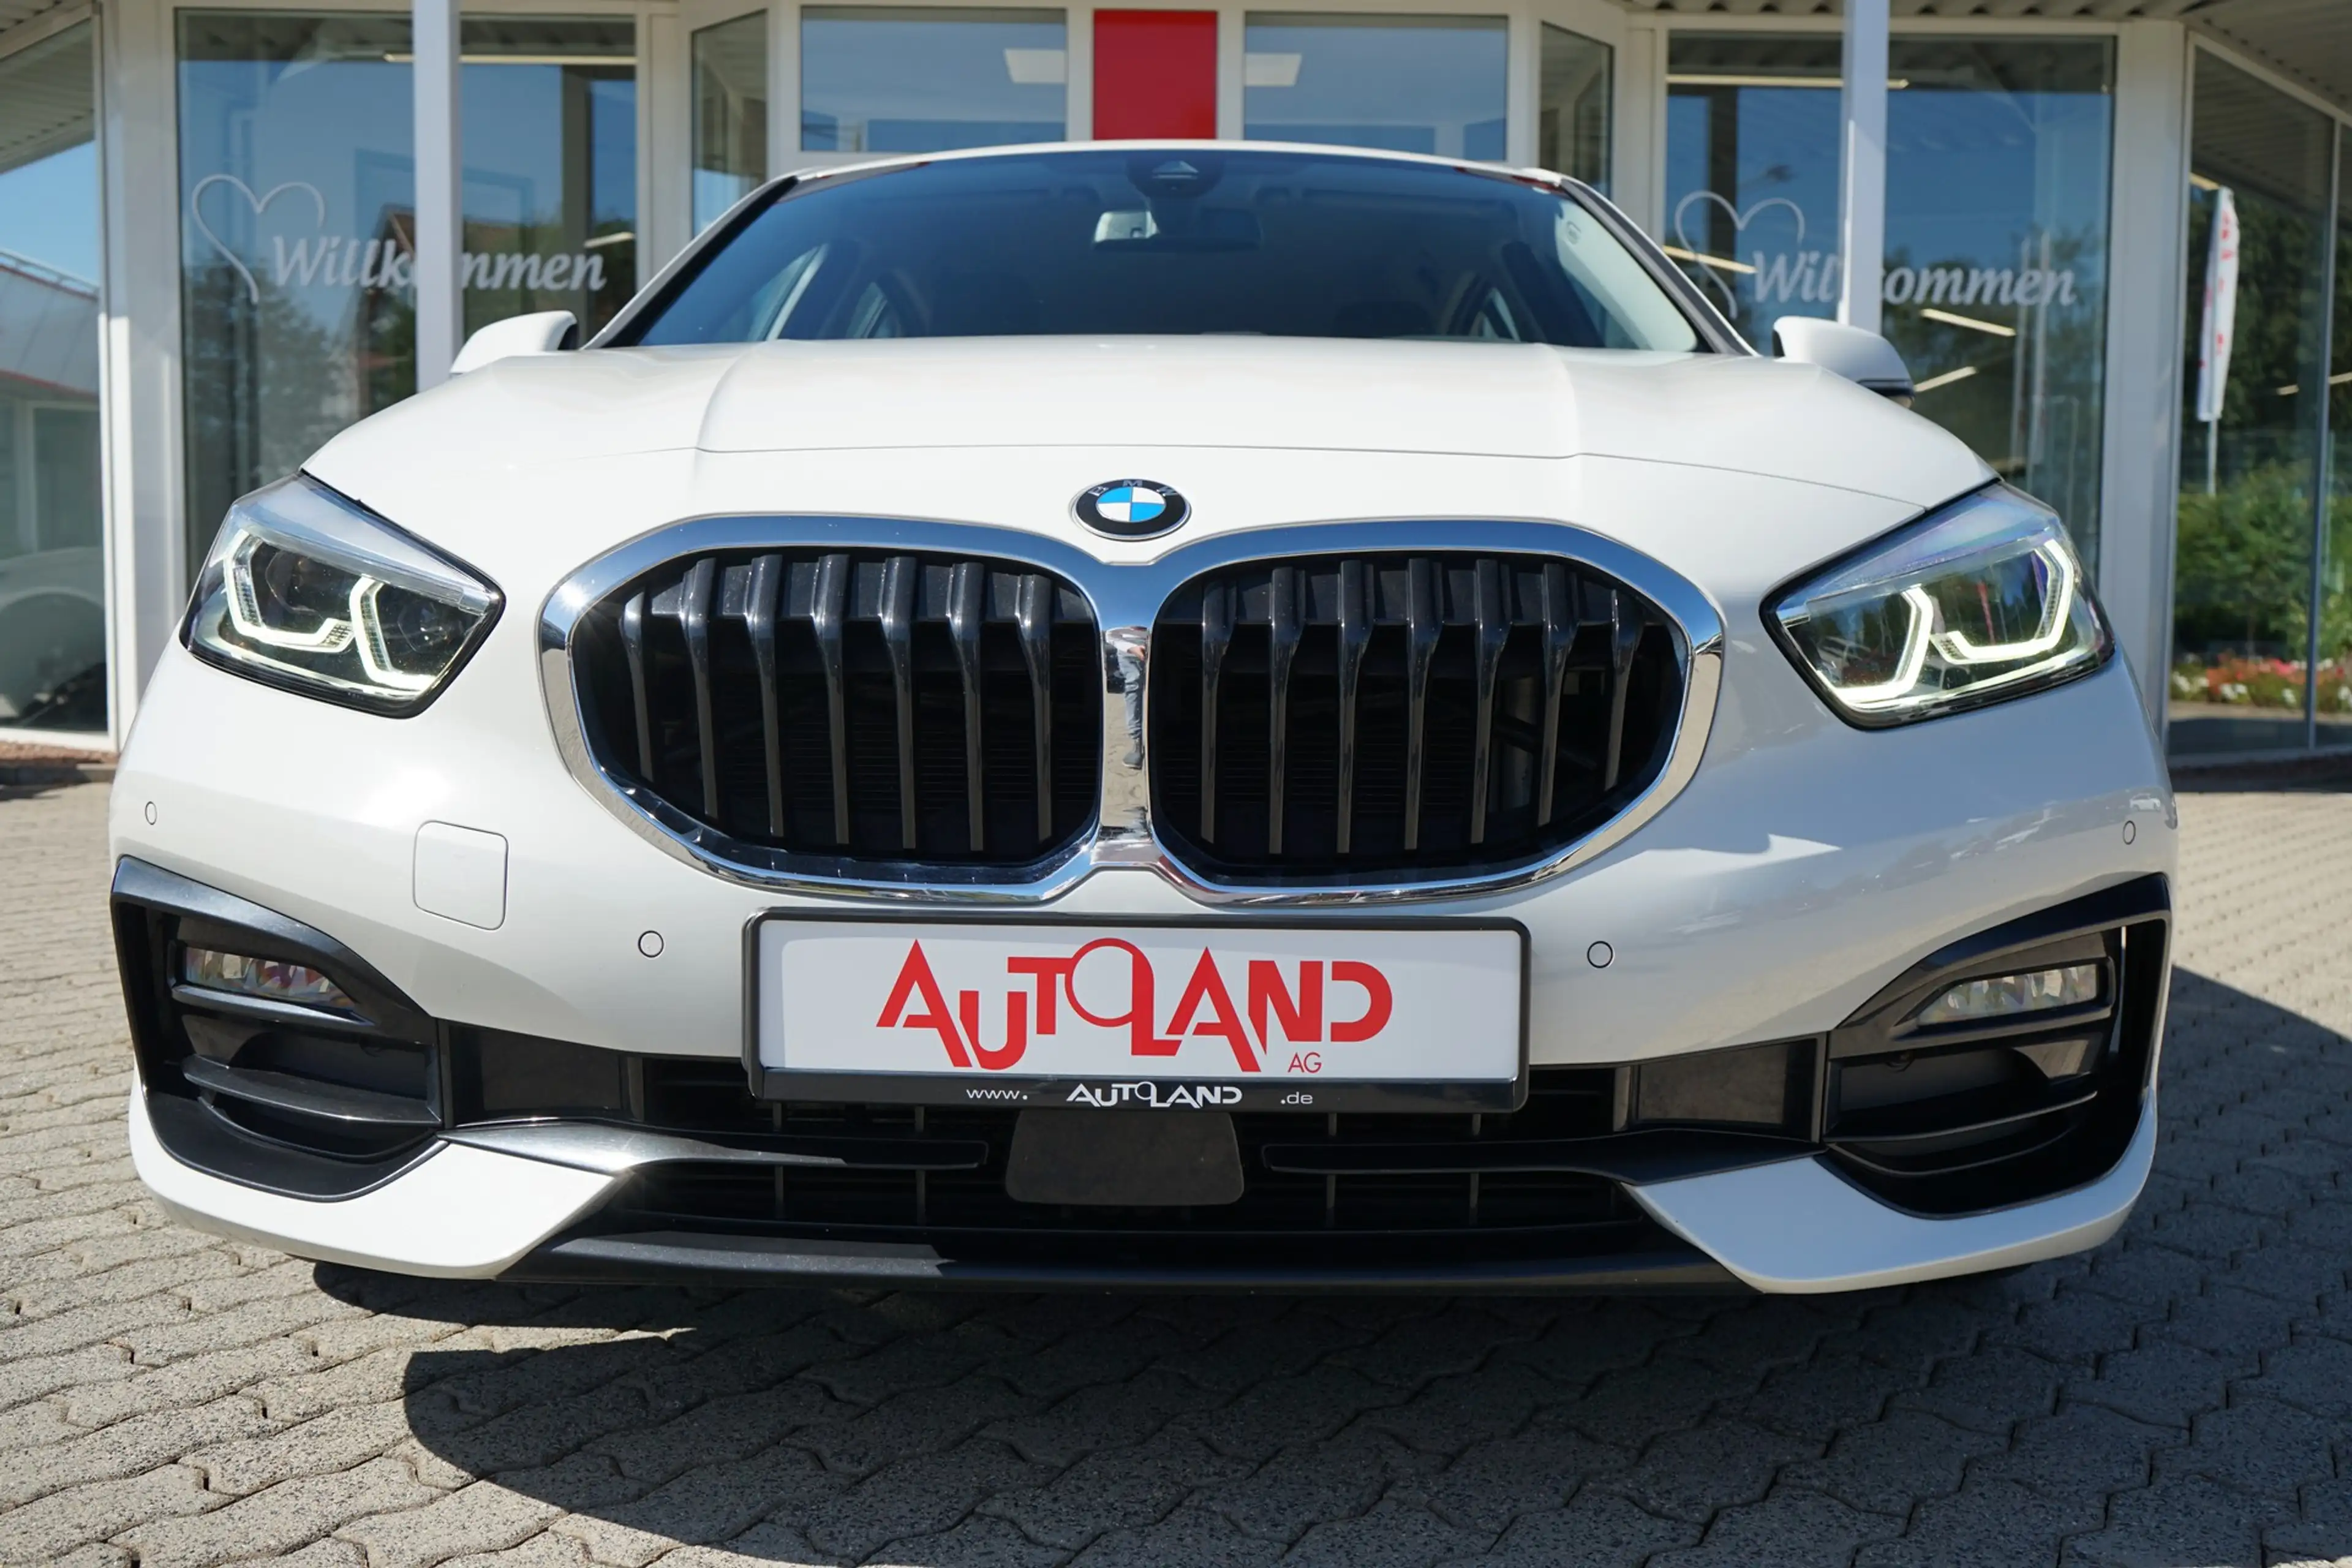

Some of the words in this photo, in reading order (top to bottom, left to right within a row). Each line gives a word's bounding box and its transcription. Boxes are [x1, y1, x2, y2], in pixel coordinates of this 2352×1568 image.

[273, 235, 606, 292] Willkmmen
[1752, 250, 2078, 306] Wilommen
[876, 938, 1393, 1072] AUTOLAND
[1287, 1052, 1322, 1074] AG
